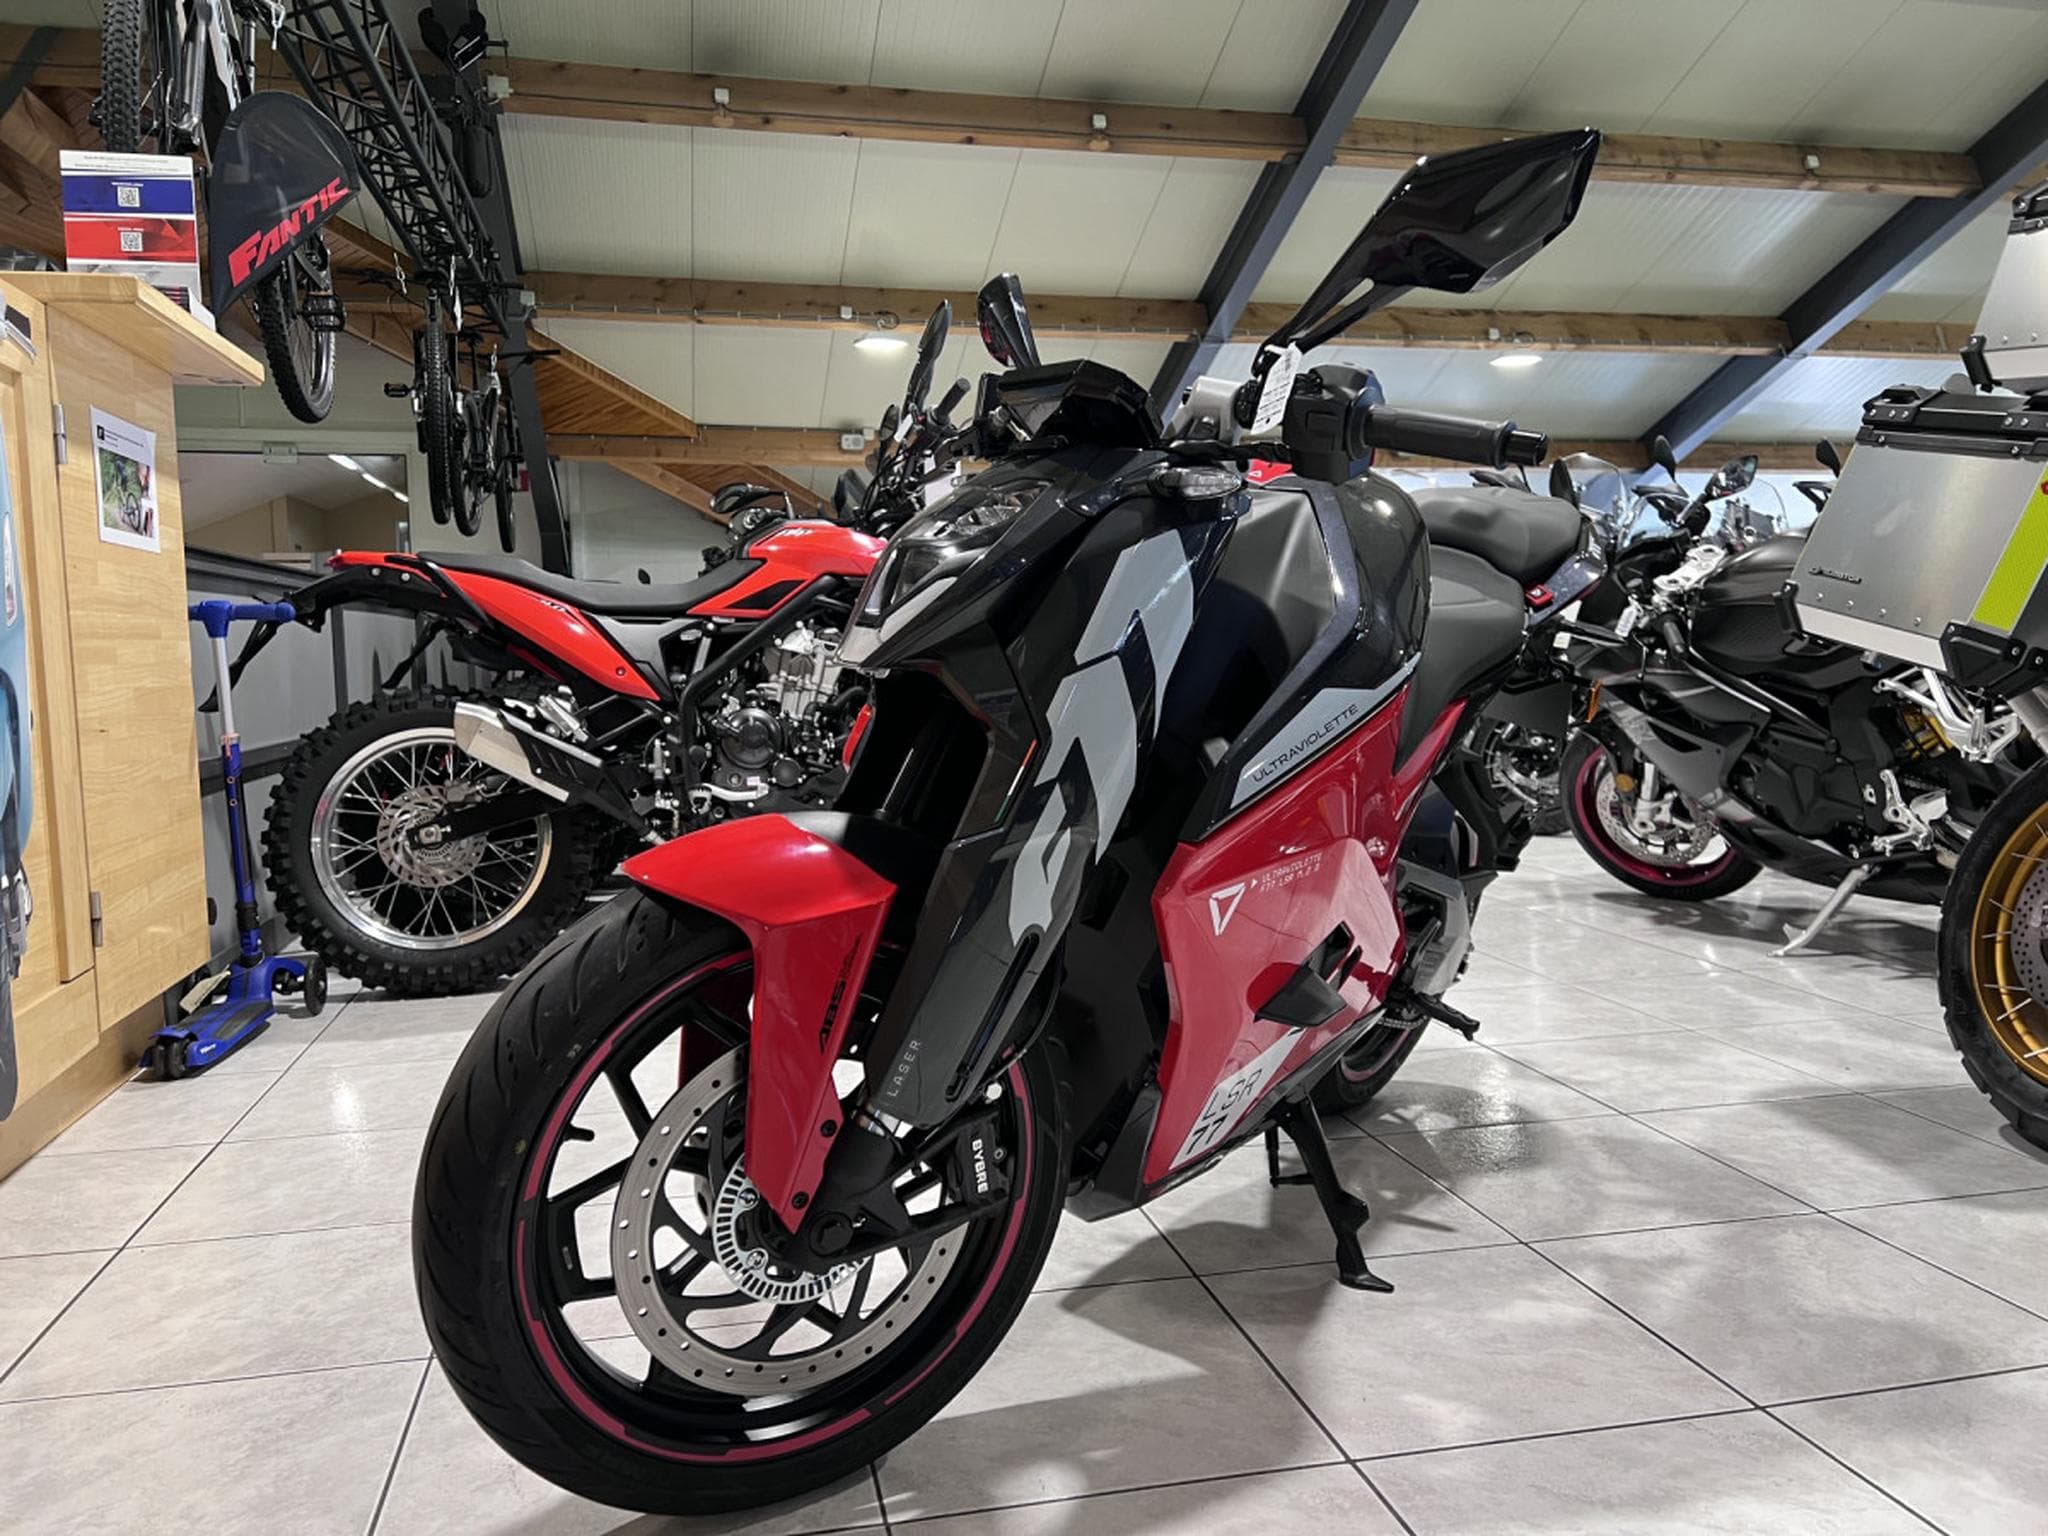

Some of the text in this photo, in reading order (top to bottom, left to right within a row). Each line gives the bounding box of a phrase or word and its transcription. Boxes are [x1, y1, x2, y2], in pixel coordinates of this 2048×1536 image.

[228, 176, 349, 288] FANTIC
[1252, 703, 1359, 783] ULTRAVIOLETTE
[887, 1039, 921, 1097] LASER
[1201, 1068, 1263, 1121] LSR
[1185, 1113, 1229, 1156] 77
[971, 1138, 989, 1194] BYBRE
